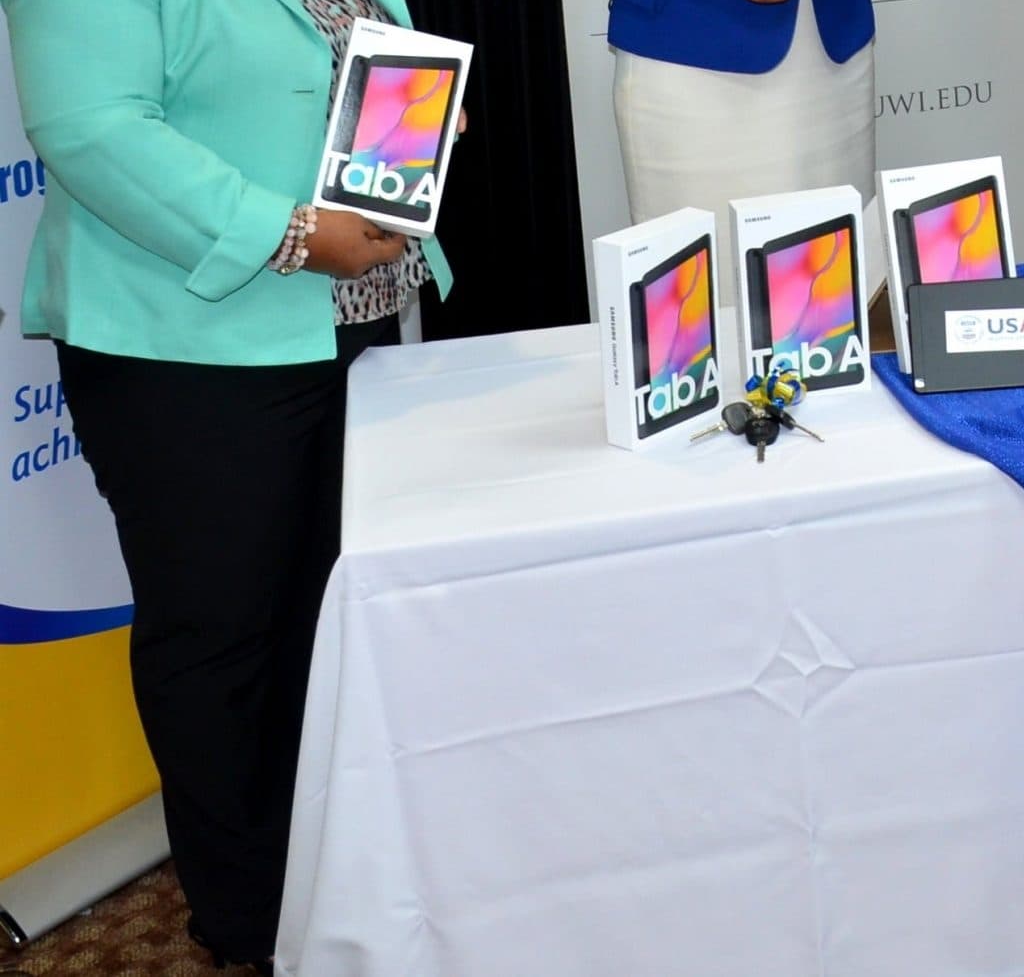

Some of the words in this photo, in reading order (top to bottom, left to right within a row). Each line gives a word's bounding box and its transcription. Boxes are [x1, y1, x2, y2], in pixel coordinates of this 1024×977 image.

[325, 150, 405, 201] Tab
[407, 172, 439, 206] A
[839, 334, 865, 372] A
[634, 371, 696, 425] Tab
[700, 357, 720, 399] A
